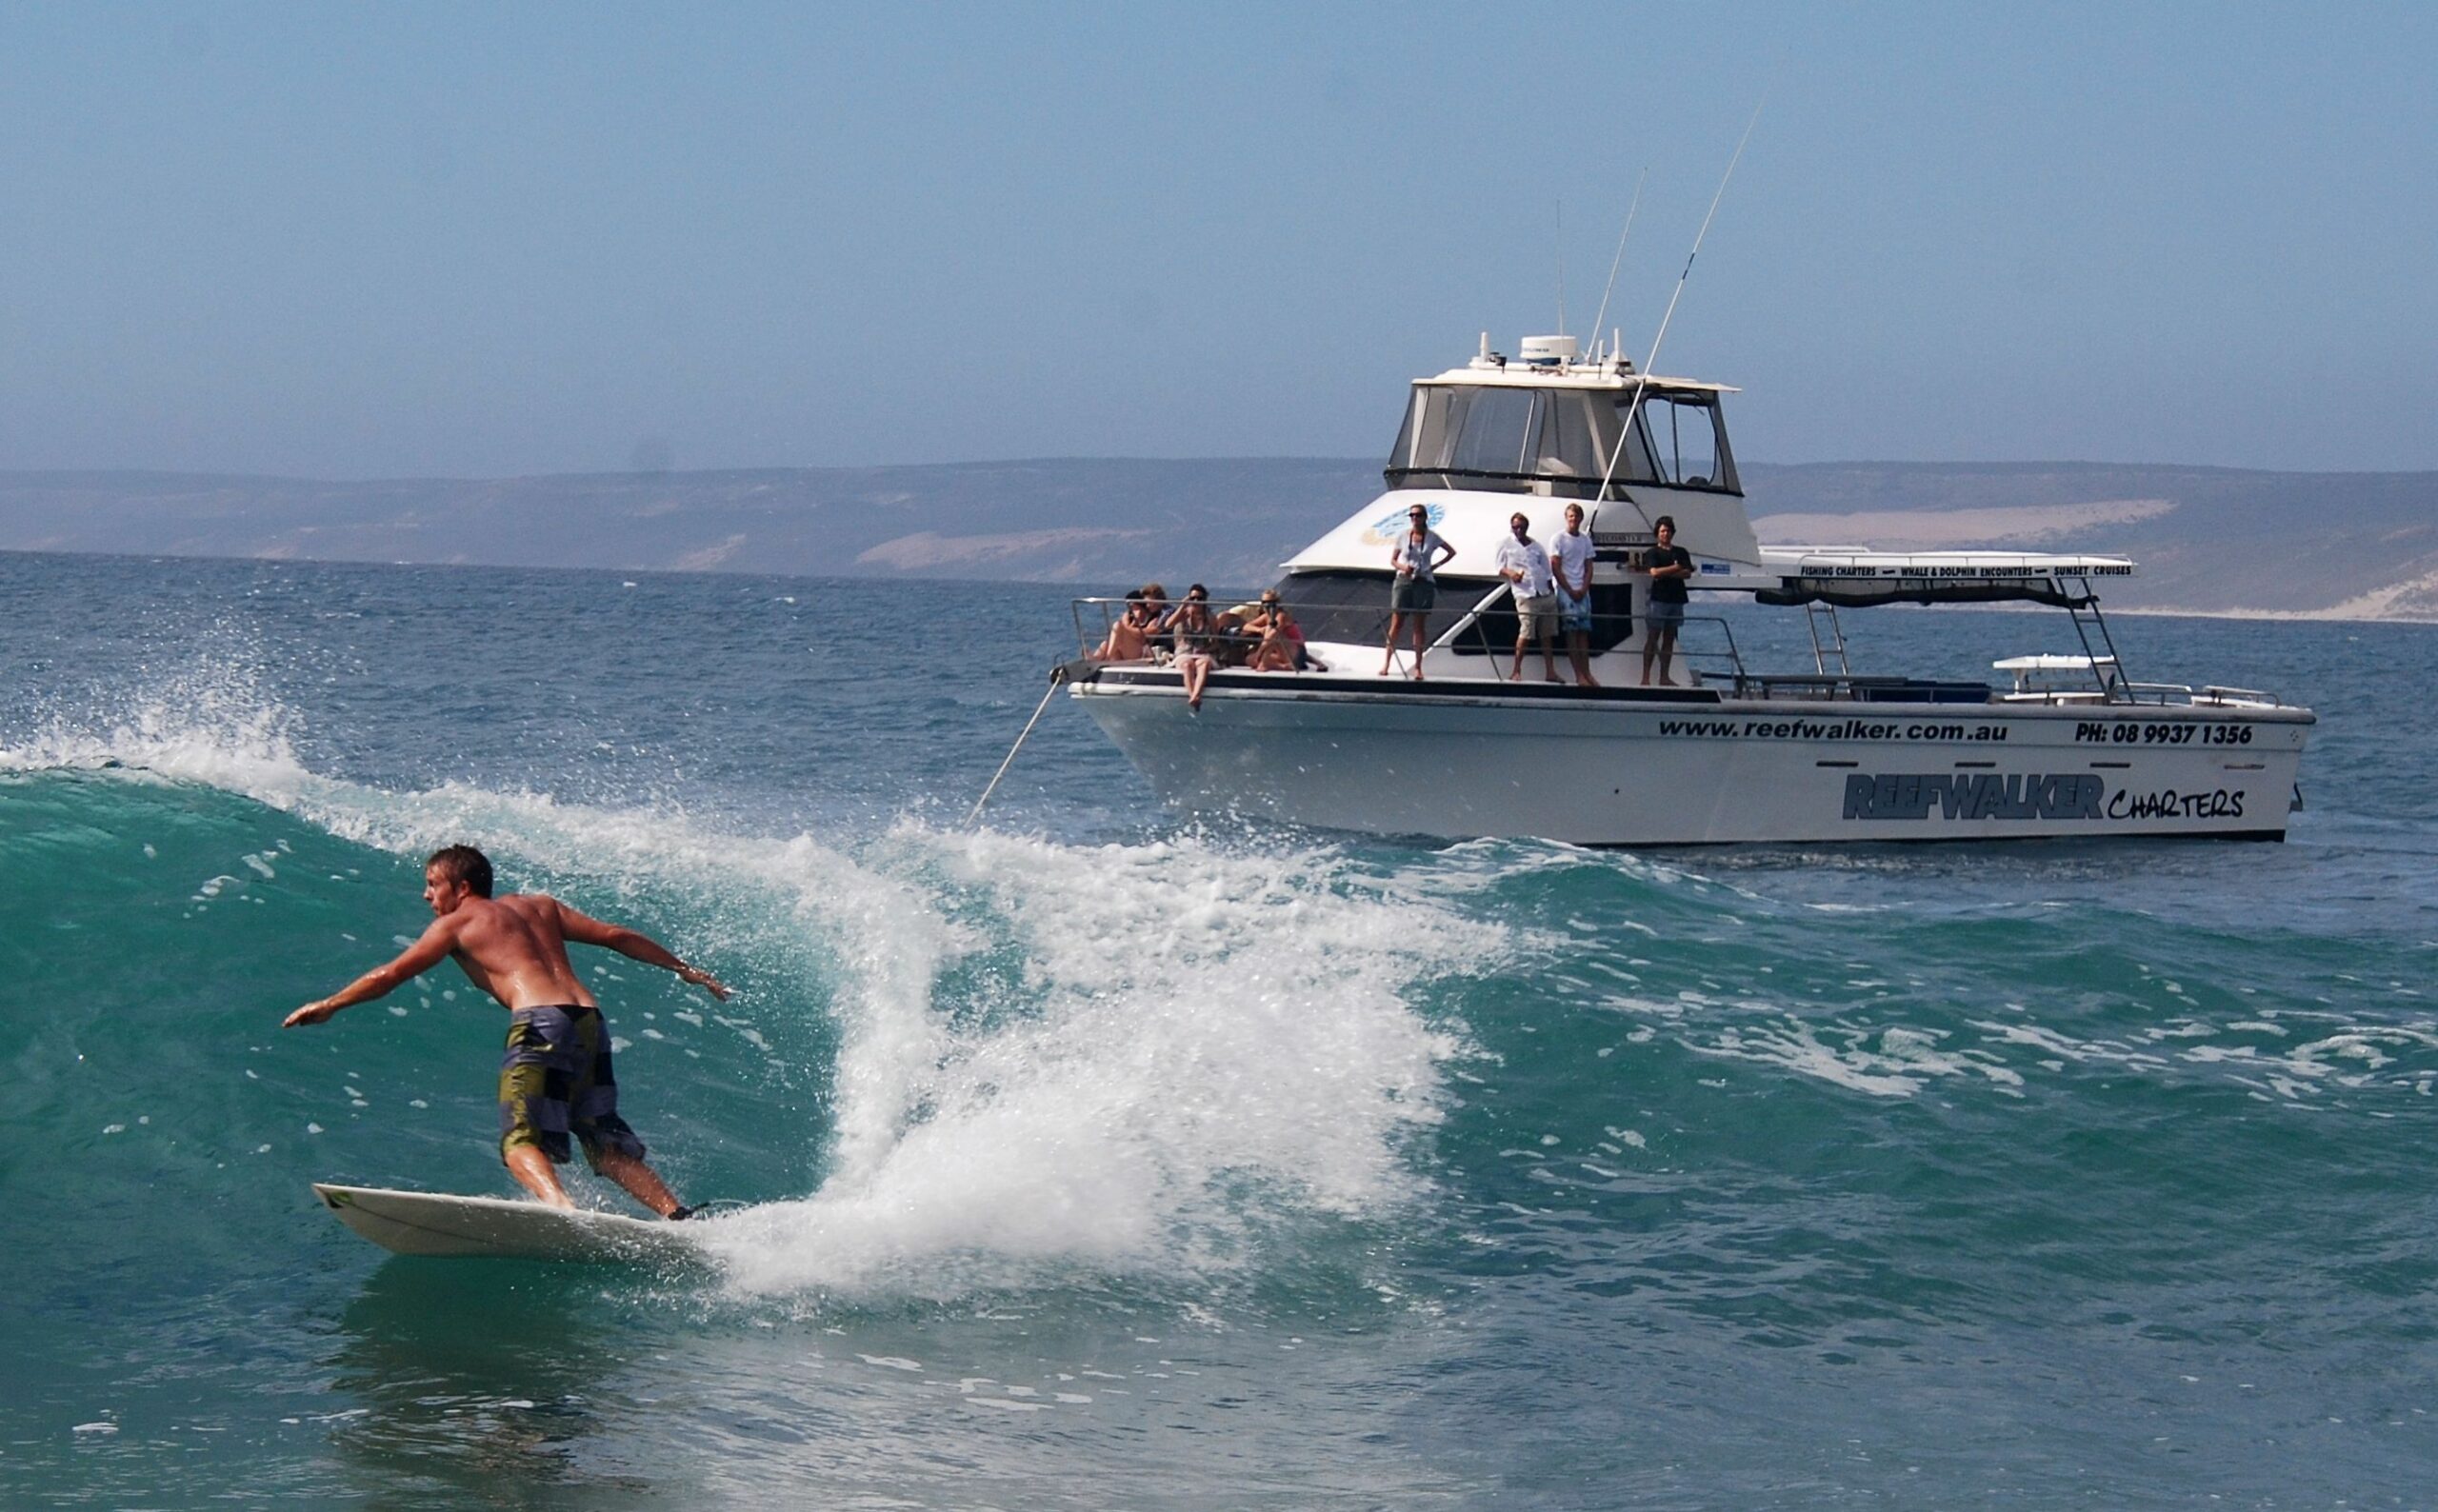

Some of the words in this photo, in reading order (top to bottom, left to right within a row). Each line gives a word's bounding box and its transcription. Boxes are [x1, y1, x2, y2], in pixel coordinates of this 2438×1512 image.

[1800, 566, 1833, 576] FISHING
[1835, 566, 1876, 576] CHARTERS
[1901, 566, 1928, 576] WHALE
[1930, 567, 1937, 577] &
[1939, 566, 1976, 577] DOLPHIN
[1980, 567, 2032, 577] ENCOUNTERS
[2053, 566, 2088, 576] SUNSET
[2093, 565, 2132, 575] CRUISES
[1658, 719, 2008, 741] www.reefwalker.com.au
[2075, 723, 2108, 743] PH:
[2112, 724, 2140, 744] 08
[2144, 725, 2197, 744] 9937
[2203, 726, 2253, 745] 1356
[1842, 773, 2105, 820] REEFWALKER
[2108, 789, 2246, 819] CHARTERS
